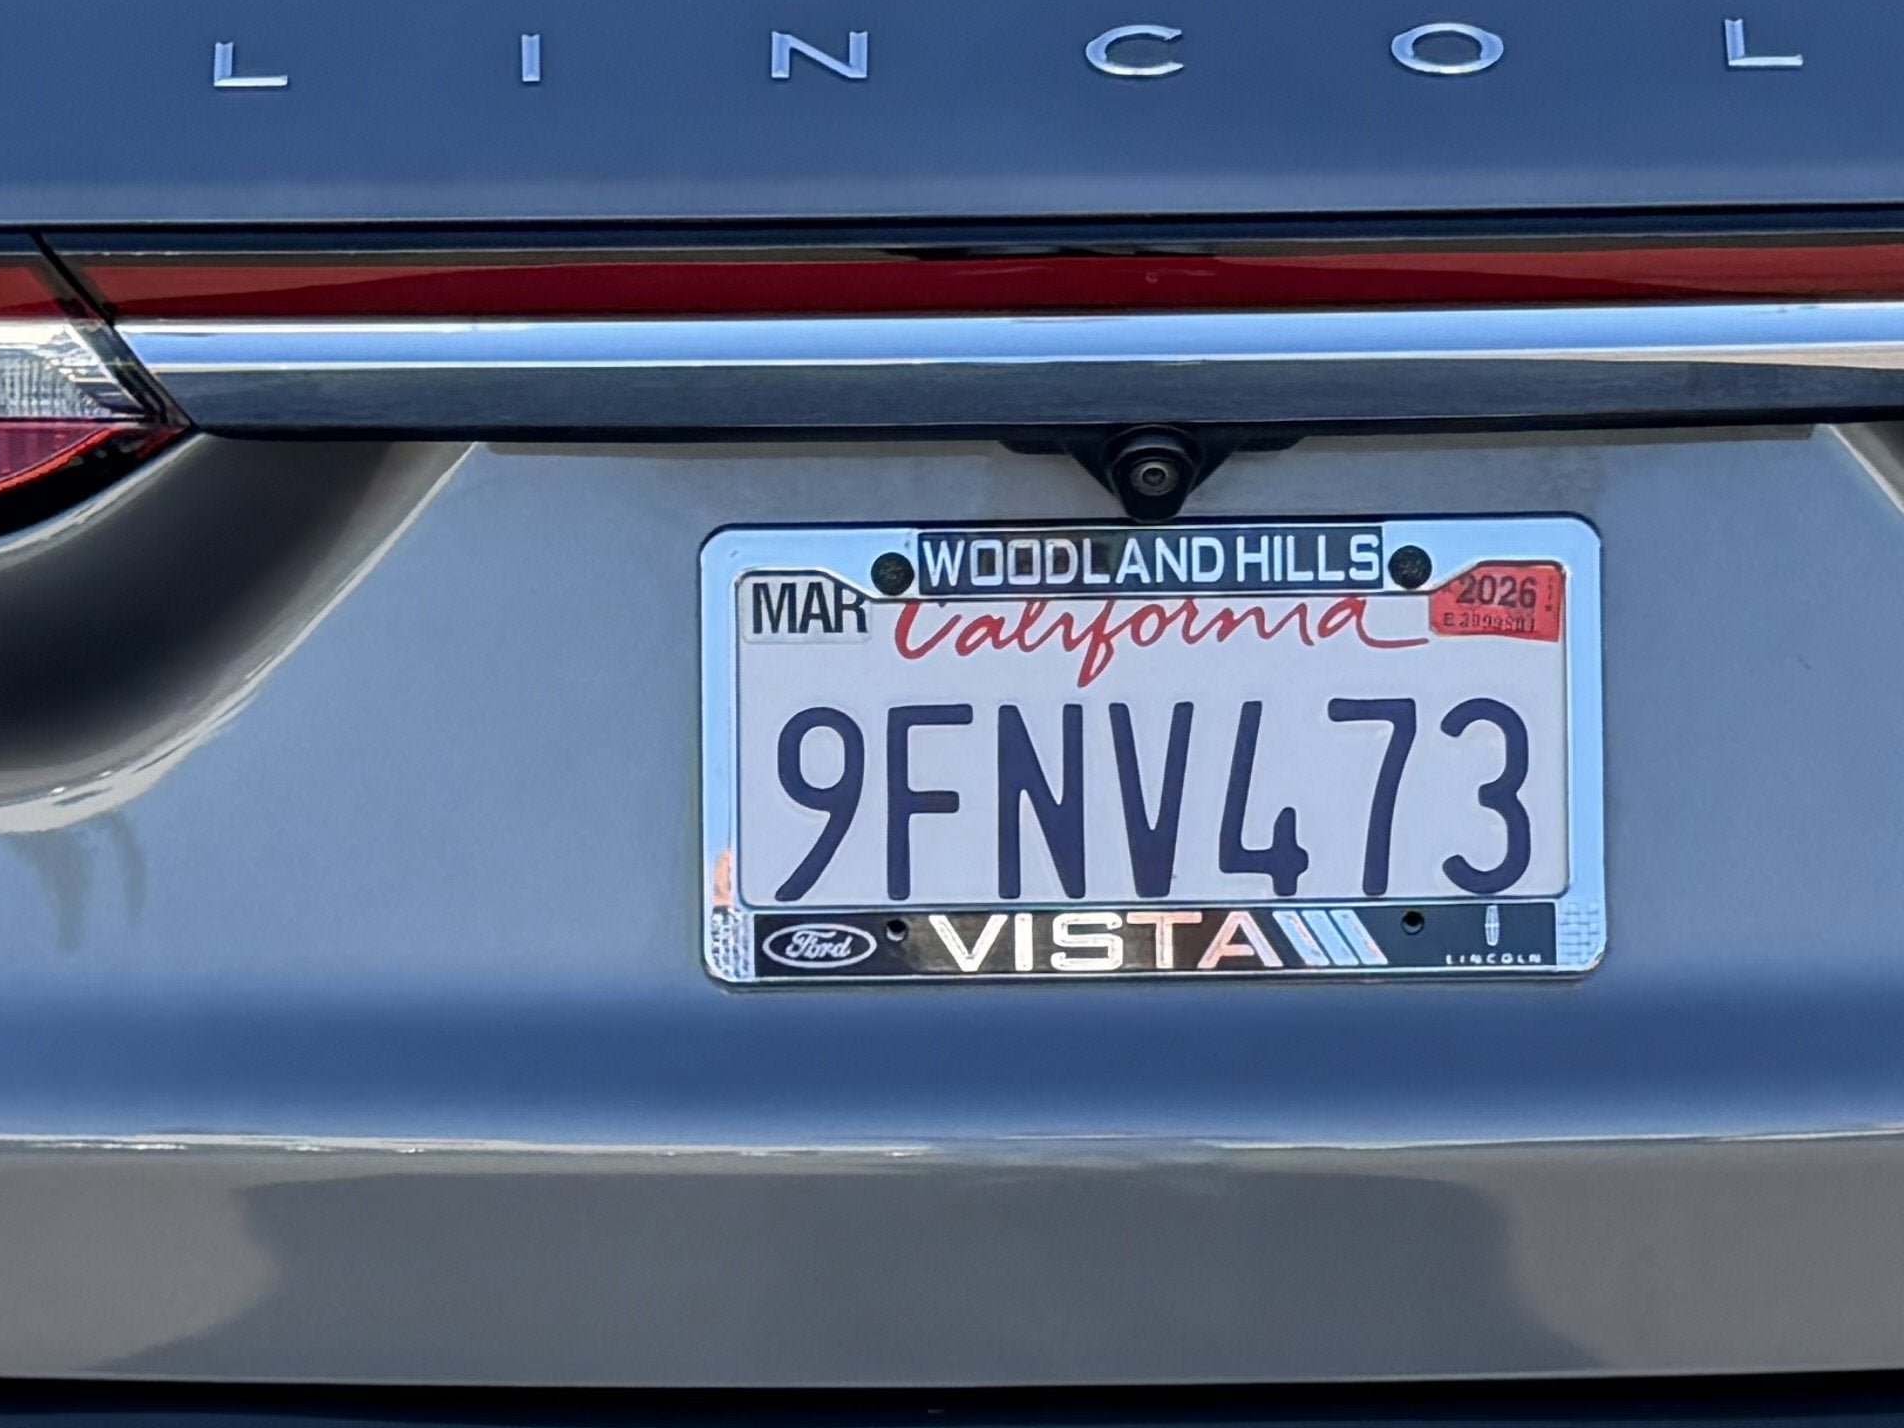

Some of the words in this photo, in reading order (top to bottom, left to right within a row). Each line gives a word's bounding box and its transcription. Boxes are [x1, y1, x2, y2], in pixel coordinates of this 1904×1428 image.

[752, 581, 869, 634] MAR
[1456, 574, 1537, 608] 2026
[895, 597, 1430, 688] California
[775, 698, 1531, 902] 9FNV473
[785, 930, 853, 960] Ford
[928, 911, 1284, 972] VISTA
[1445, 952, 1542, 965] LINCOLN
